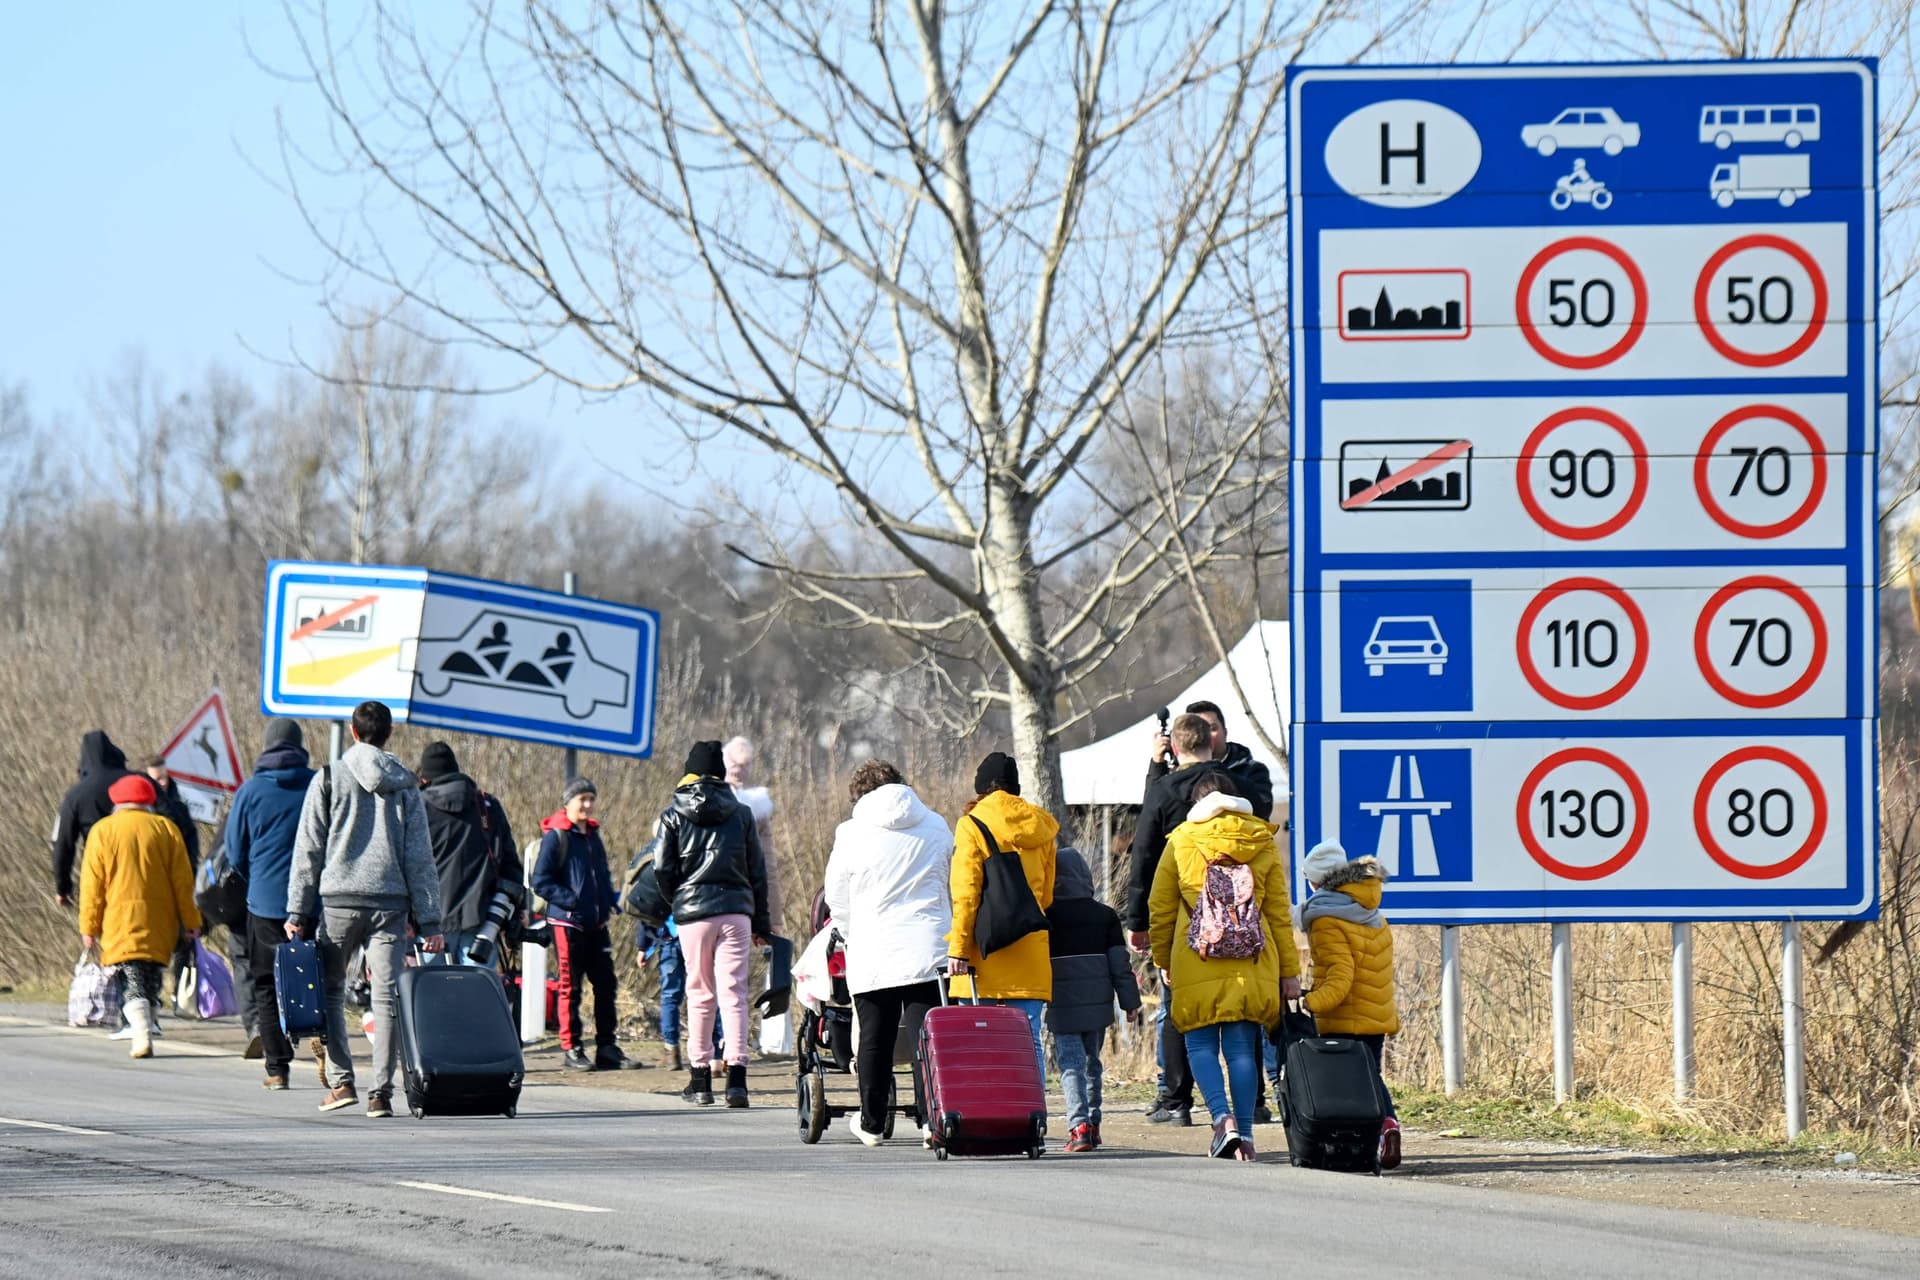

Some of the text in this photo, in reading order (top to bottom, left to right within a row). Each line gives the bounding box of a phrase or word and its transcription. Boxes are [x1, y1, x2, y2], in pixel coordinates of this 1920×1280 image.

[1380, 122, 1425, 185] H
[1549, 279, 1615, 328] 50
[1727, 276, 1793, 325] 50
[1549, 448, 1615, 499] 90
[1728, 446, 1791, 497] 70
[1547, 619, 1618, 668] 110
[1729, 617, 1792, 667] 70
[1540, 789, 1625, 839] 130
[1727, 788, 1794, 838] 80
